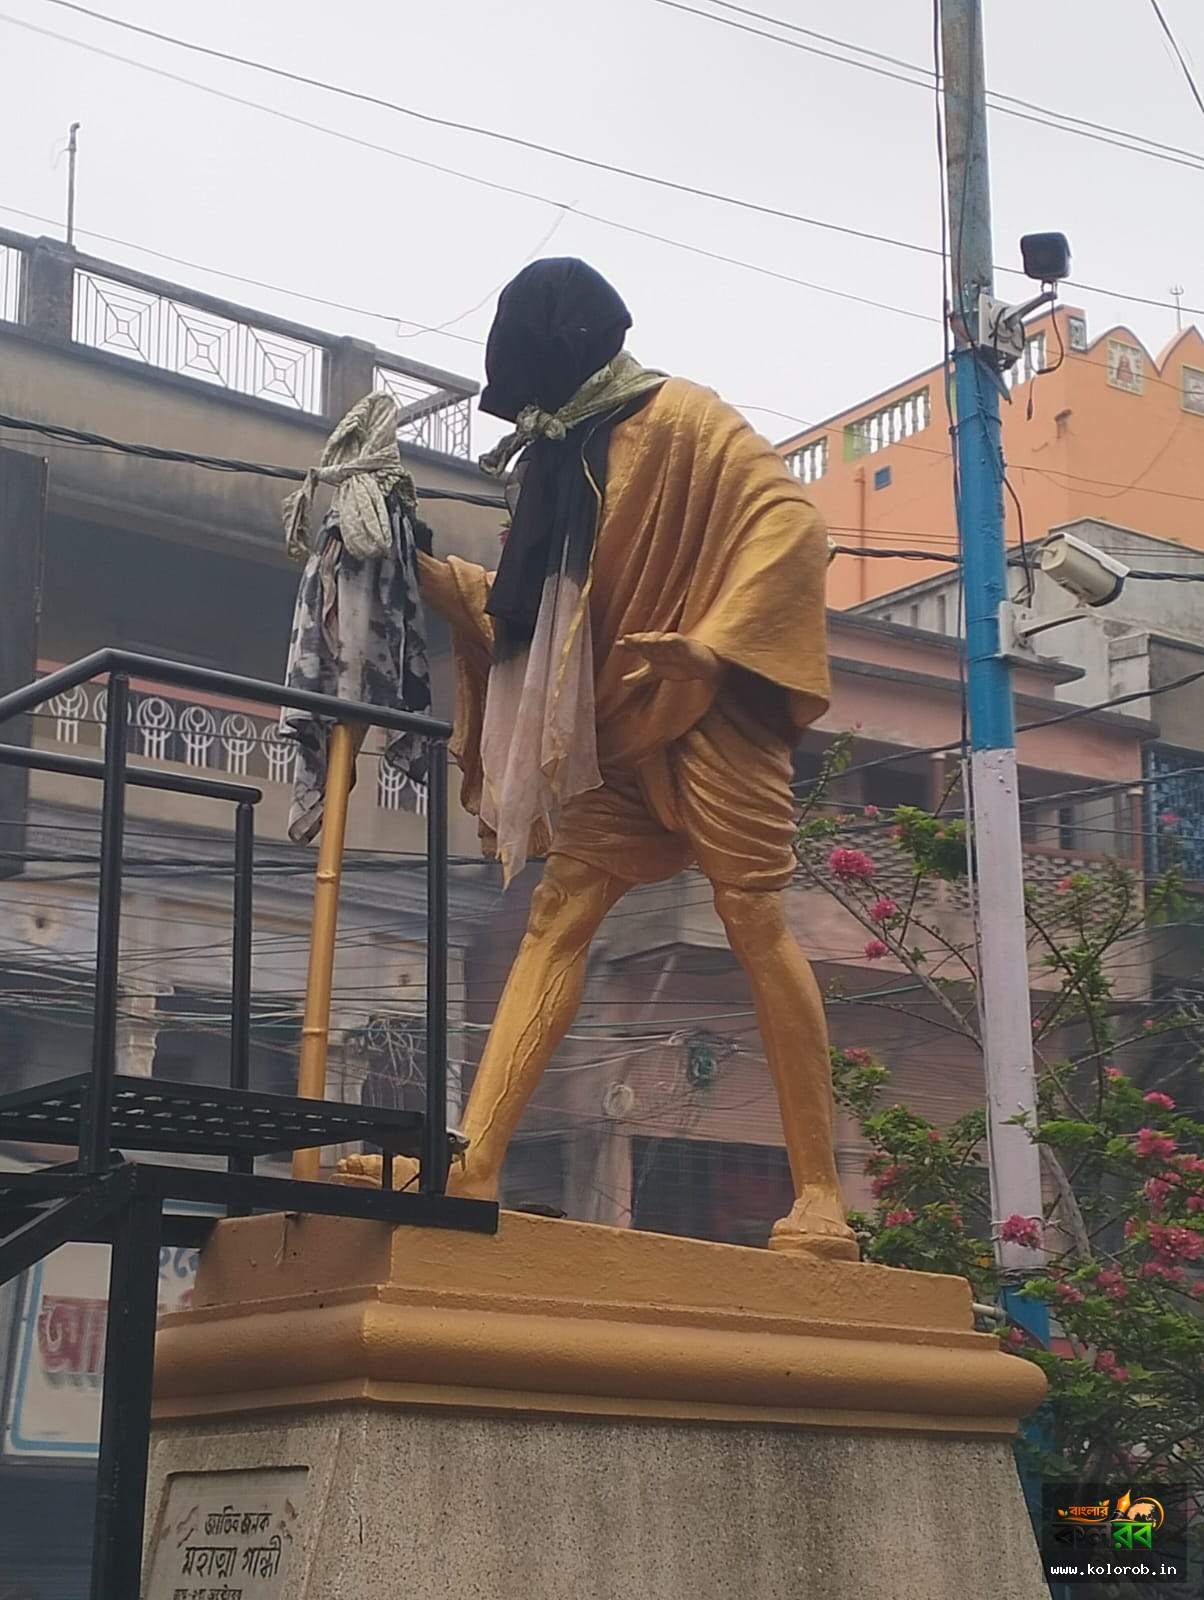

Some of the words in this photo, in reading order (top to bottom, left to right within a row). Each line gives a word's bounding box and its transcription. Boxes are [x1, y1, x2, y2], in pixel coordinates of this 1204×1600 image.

[240, 1512, 273, 1536] জনক
[181, 1546, 238, 1579] মহাত্মা
[241, 1535, 282, 1579] গান্ধী
